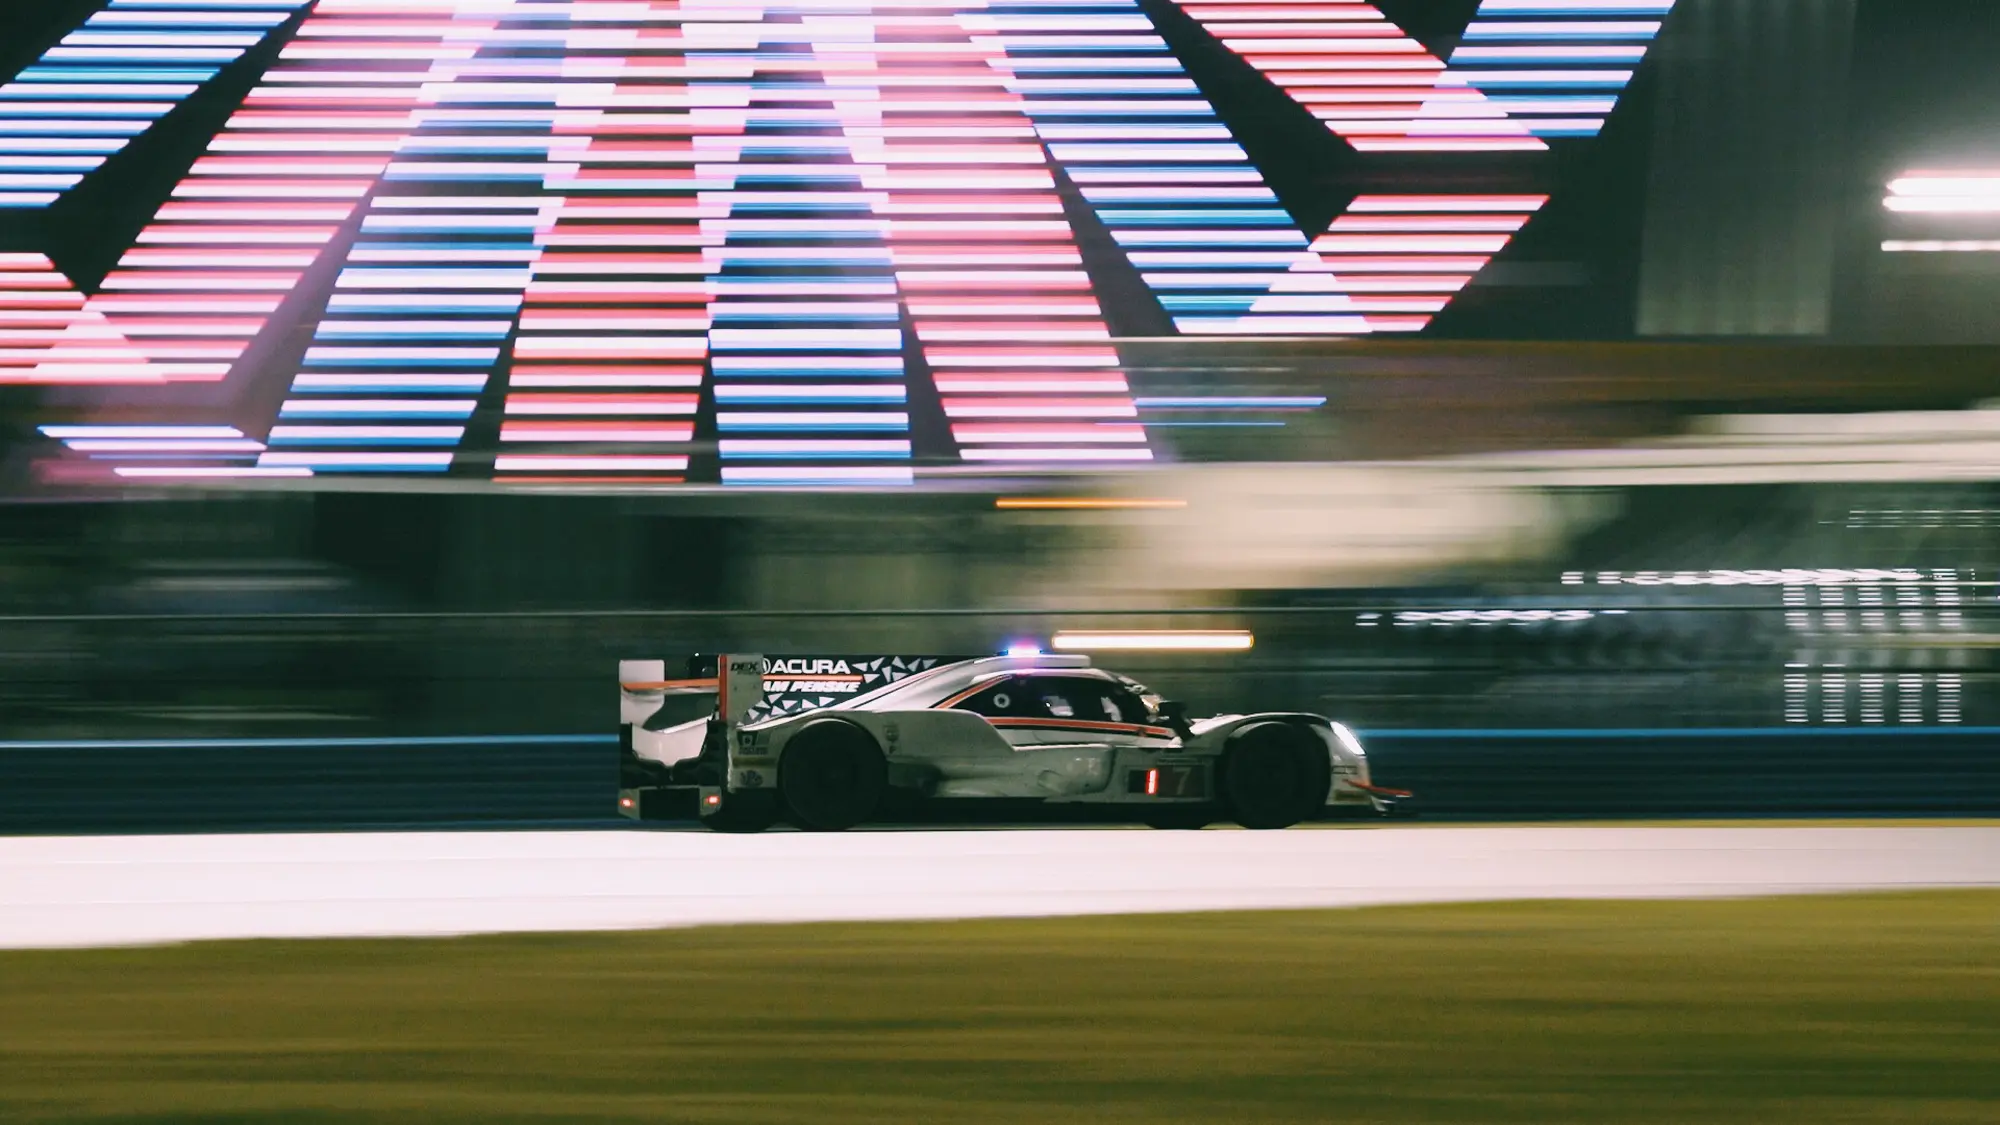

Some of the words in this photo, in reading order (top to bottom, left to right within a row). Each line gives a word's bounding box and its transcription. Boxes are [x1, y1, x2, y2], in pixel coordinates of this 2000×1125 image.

[771, 659, 851, 674] ACURA
[789, 681, 860, 692] PENSKE
[1173, 766, 1192, 795] 7
